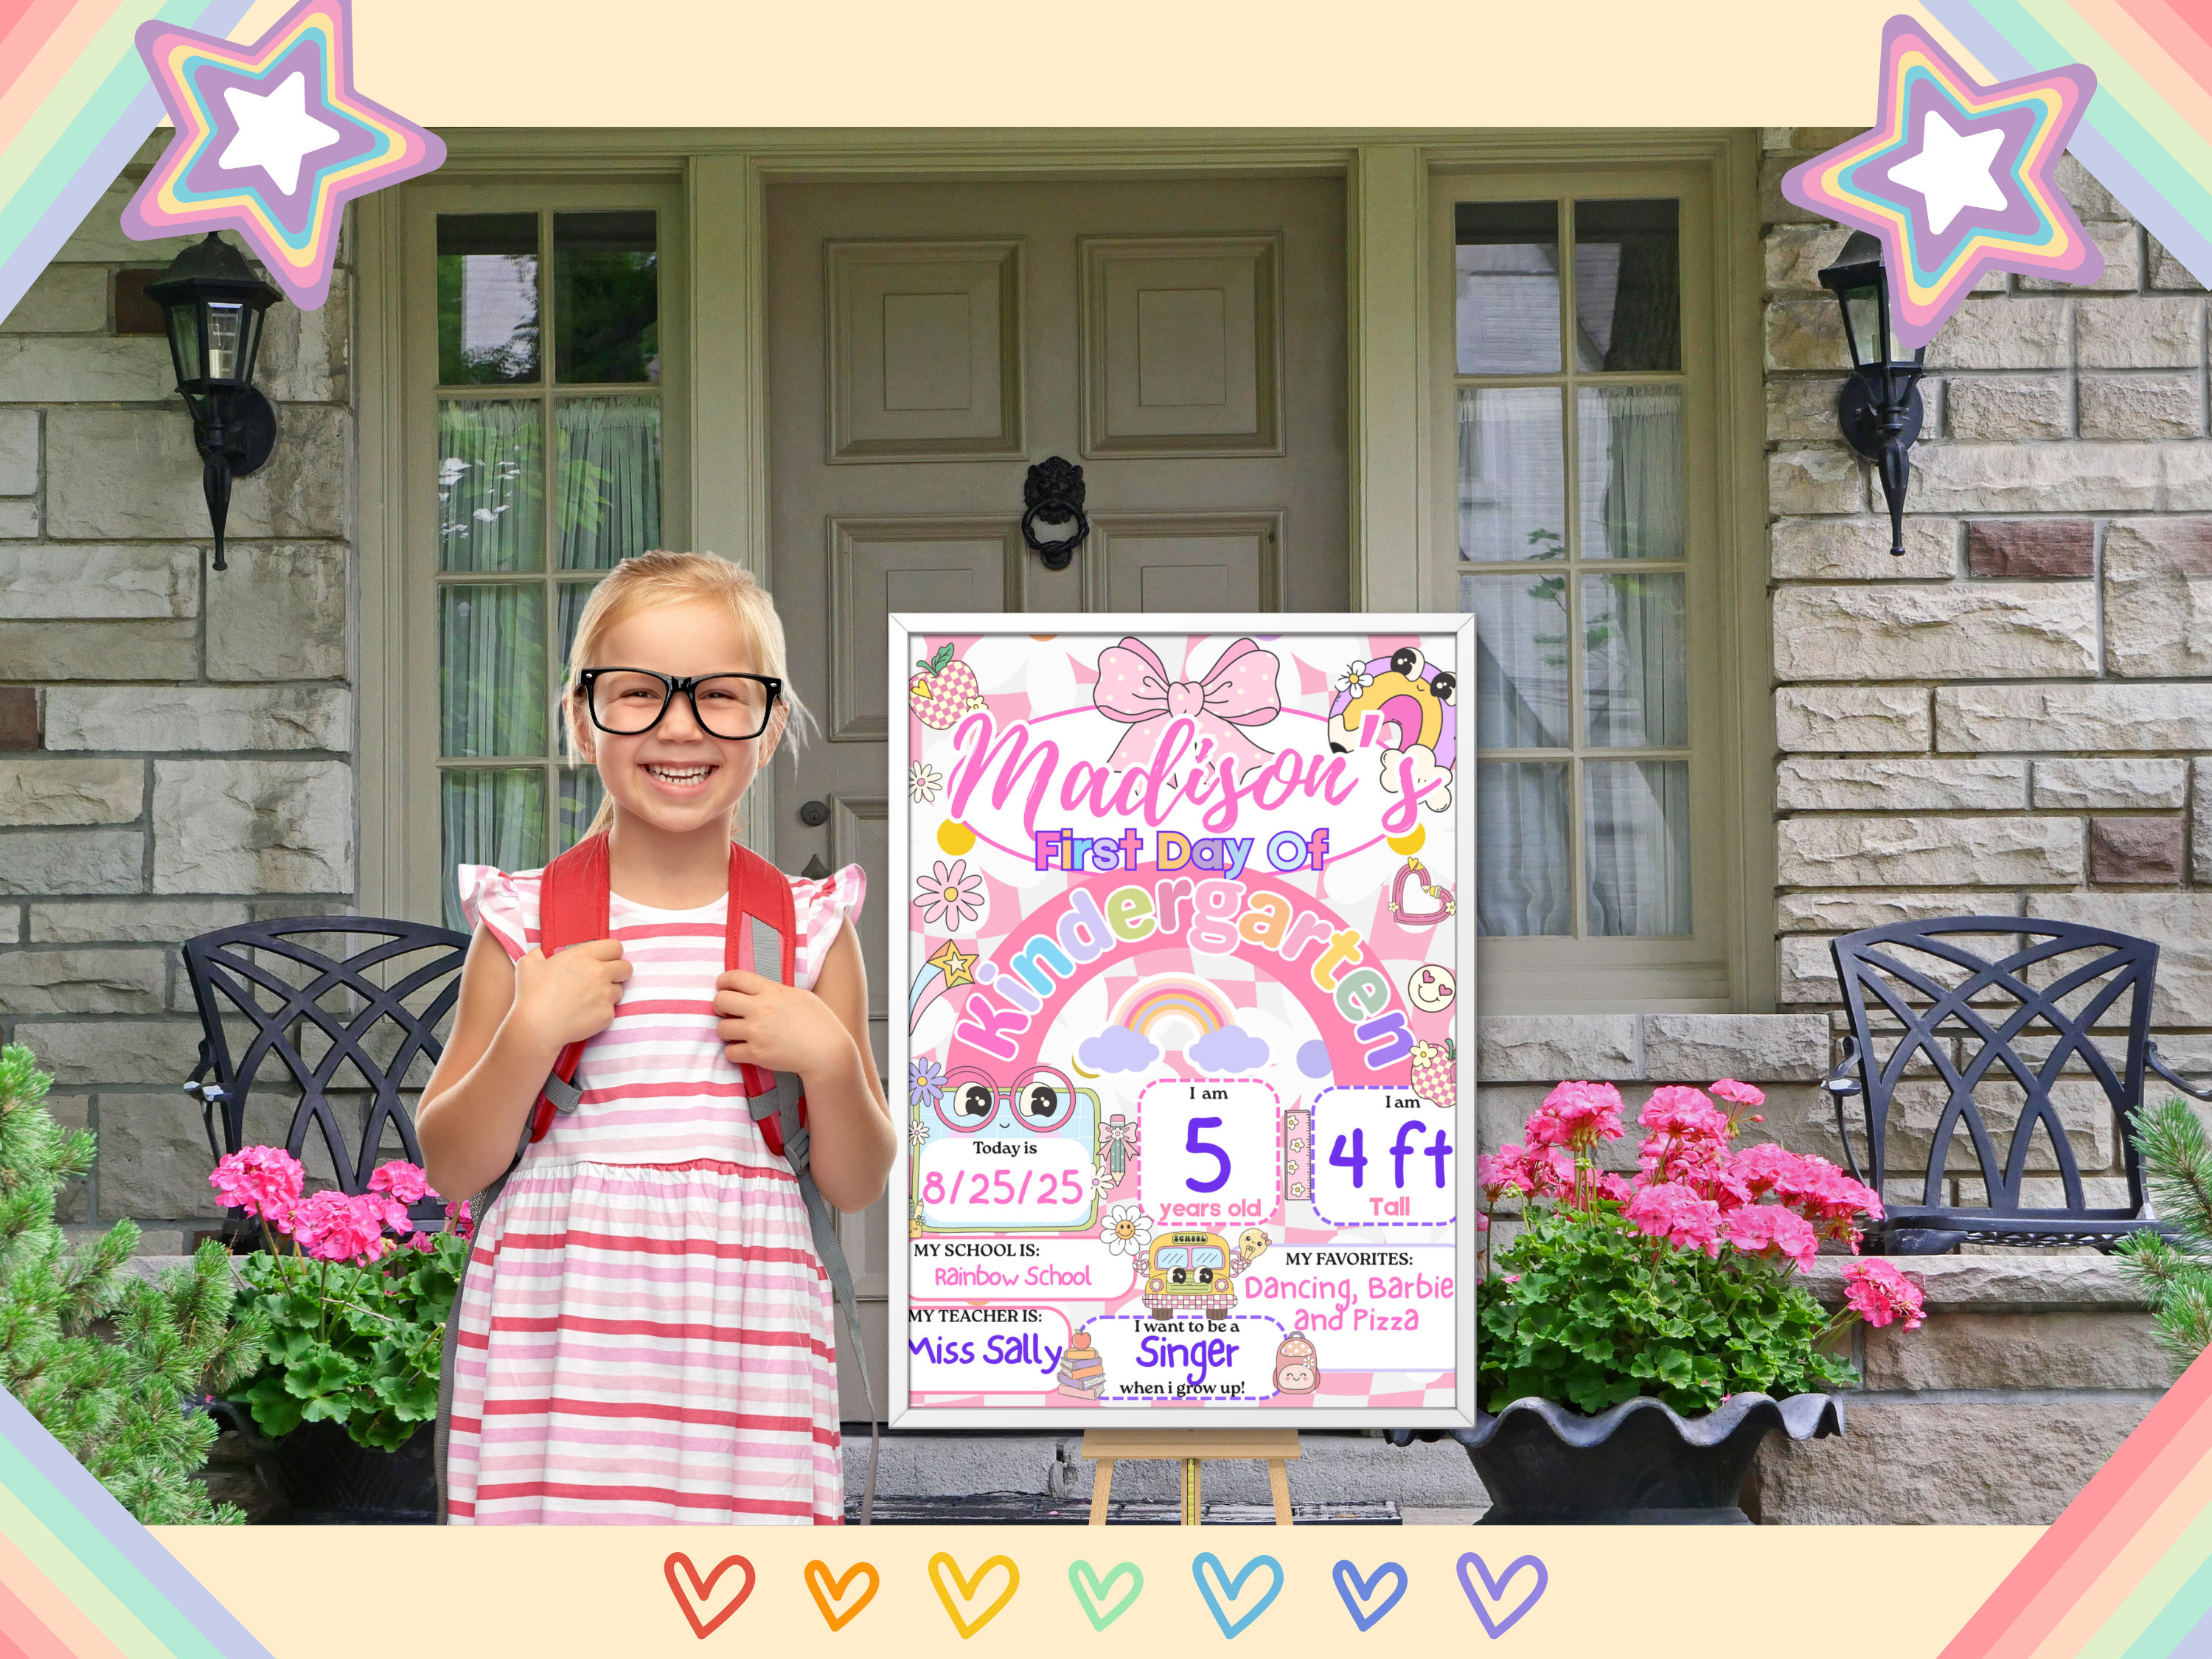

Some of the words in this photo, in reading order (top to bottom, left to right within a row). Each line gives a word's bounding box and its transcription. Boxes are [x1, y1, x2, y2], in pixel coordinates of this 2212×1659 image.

[950, 712, 1441, 834] Madison's
[1034, 827, 1144, 871] First
[1156, 830, 1255, 880] Day
[1266, 827, 1329, 871] Of
[956, 880, 1416, 1068] Kindergarten
[1189, 1087, 1195, 1099] I
[1202, 1089, 1228, 1099] am
[1385, 1096, 1391, 1108] I
[1394, 1098, 1421, 1108] am
[973, 1141, 1020, 1157] Today
[1024, 1141, 1037, 1154] is
[1186, 1116, 1231, 1193] 5
[1329, 1128, 1368, 1189] 4
[1389, 1120, 1453, 1189] ft
[922, 1169, 1083, 1205] 8/25/25
[1160, 1202, 1221, 1221] years
[1228, 1199, 1262, 1217] old
[1369, 1196, 1410, 1216] Tall
[914, 1244, 941, 1256] MY
[945, 1243, 1016, 1256] SCHOOL
[1020, 1243, 1040, 1256] IS:
[1285, 1253, 1312, 1265] MY
[1316, 1252, 1413, 1265] FAVORITES:
[935, 1264, 1019, 1287] Rainbow
[1024, 1263, 1092, 1286] School
[1245, 1276, 1357, 1312] Dancing,
[1368, 1272, 1454, 1299] Barbie
[908, 1310, 934, 1322] MY
[938, 1310, 1018, 1322] TEACHER
[1023, 1310, 1042, 1322] IS:
[1135, 1320, 1140, 1332] I
[1144, 1321, 1184, 1332] want
[1189, 1321, 1204, 1332] to
[1208, 1320, 1227, 1332] be
[1230, 1323, 1240, 1332] a
[1294, 1304, 1343, 1331] and
[1354, 1308, 1419, 1331] Pizza
[909, 1335, 975, 1365] Miss
[982, 1332, 1062, 1374] Sally
[1135, 1335, 1239, 1386] Singer
[1120, 1381, 1164, 1394] when
[1168, 1381, 1172, 1394] i
[1176, 1383, 1217, 1397] grow
[1220, 1381, 1245, 1397] up!
